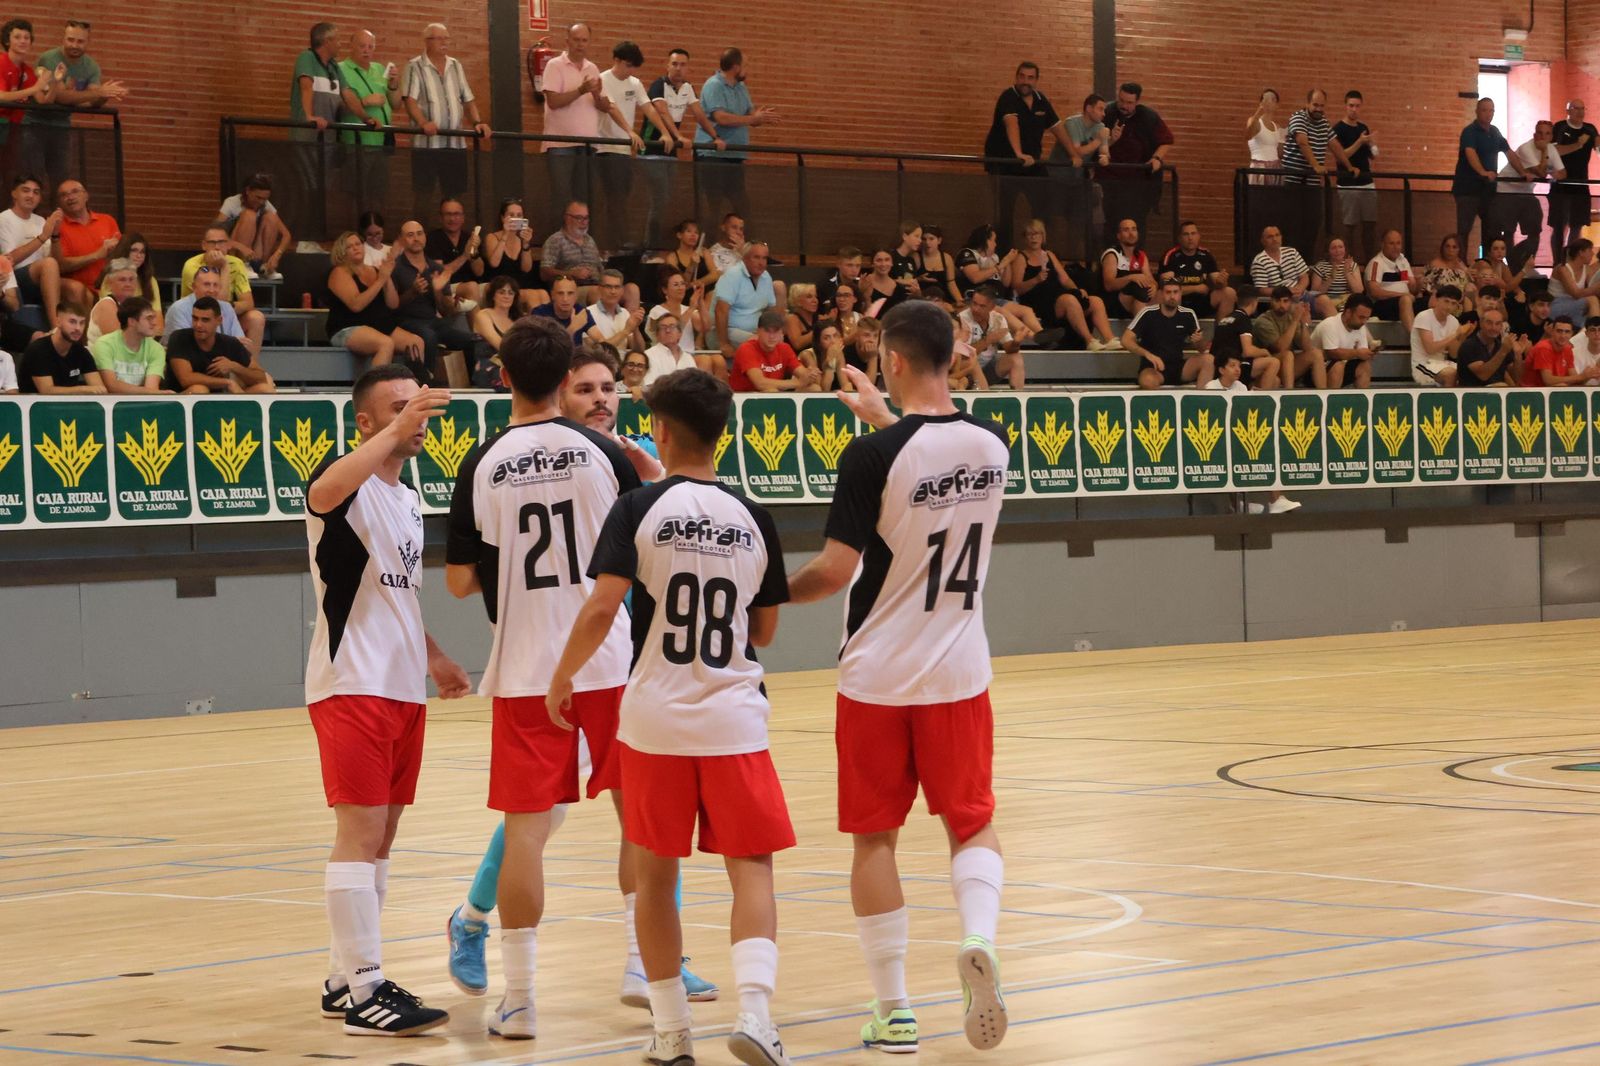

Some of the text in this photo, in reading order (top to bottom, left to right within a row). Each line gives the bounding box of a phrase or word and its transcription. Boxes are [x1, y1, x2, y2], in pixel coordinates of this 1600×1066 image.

[1375, 461, 1413, 470] CAJA RURAL
[1420, 459, 1458, 468] CAJA RURAL
[1465, 458, 1502, 467] CAJA RURAL
[1509, 457, 1546, 466] CAJA RURAL
[1552, 457, 1566, 465] CAJA
[1567, 456, 1588, 464] RURAL
[492, 450, 587, 484] alefran
[1135, 466, 1177, 476] CAJA RURAL
[1184, 465, 1226, 475] CAJA RURAL
[1234, 464, 1274, 473] CAJA RURAL
[1282, 463, 1322, 472] CAJA RURAL
[1329, 462, 1368, 471] CAJA RURAL
[1031, 469, 1076, 479] CAJA RURAL
[1084, 468, 1127, 478] CAJA RURAL
[716, 476, 741, 485] URAL
[750, 475, 800, 485] CAJA RURAL
[808, 475, 828, 484] CAJA
[423, 483, 448, 493] CAJA
[913, 468, 1002, 503] alefran
[120, 490, 188, 503] CAJA RURAL
[200, 488, 266, 500] CAJA RURAL
[278, 486, 304, 498] CAJA
[0, 494, 23, 506] RAL
[36, 492, 107, 505] CAJA RURAL
[50, 506, 96, 514] DE ZAMORA
[146, 503, 178, 511] ZAMORA
[657, 519, 752, 546] alefran
[519, 499, 581, 590] 21
[924, 523, 983, 612] 14
[380, 572, 410, 589] CAJA
[663, 572, 738, 668] 98
